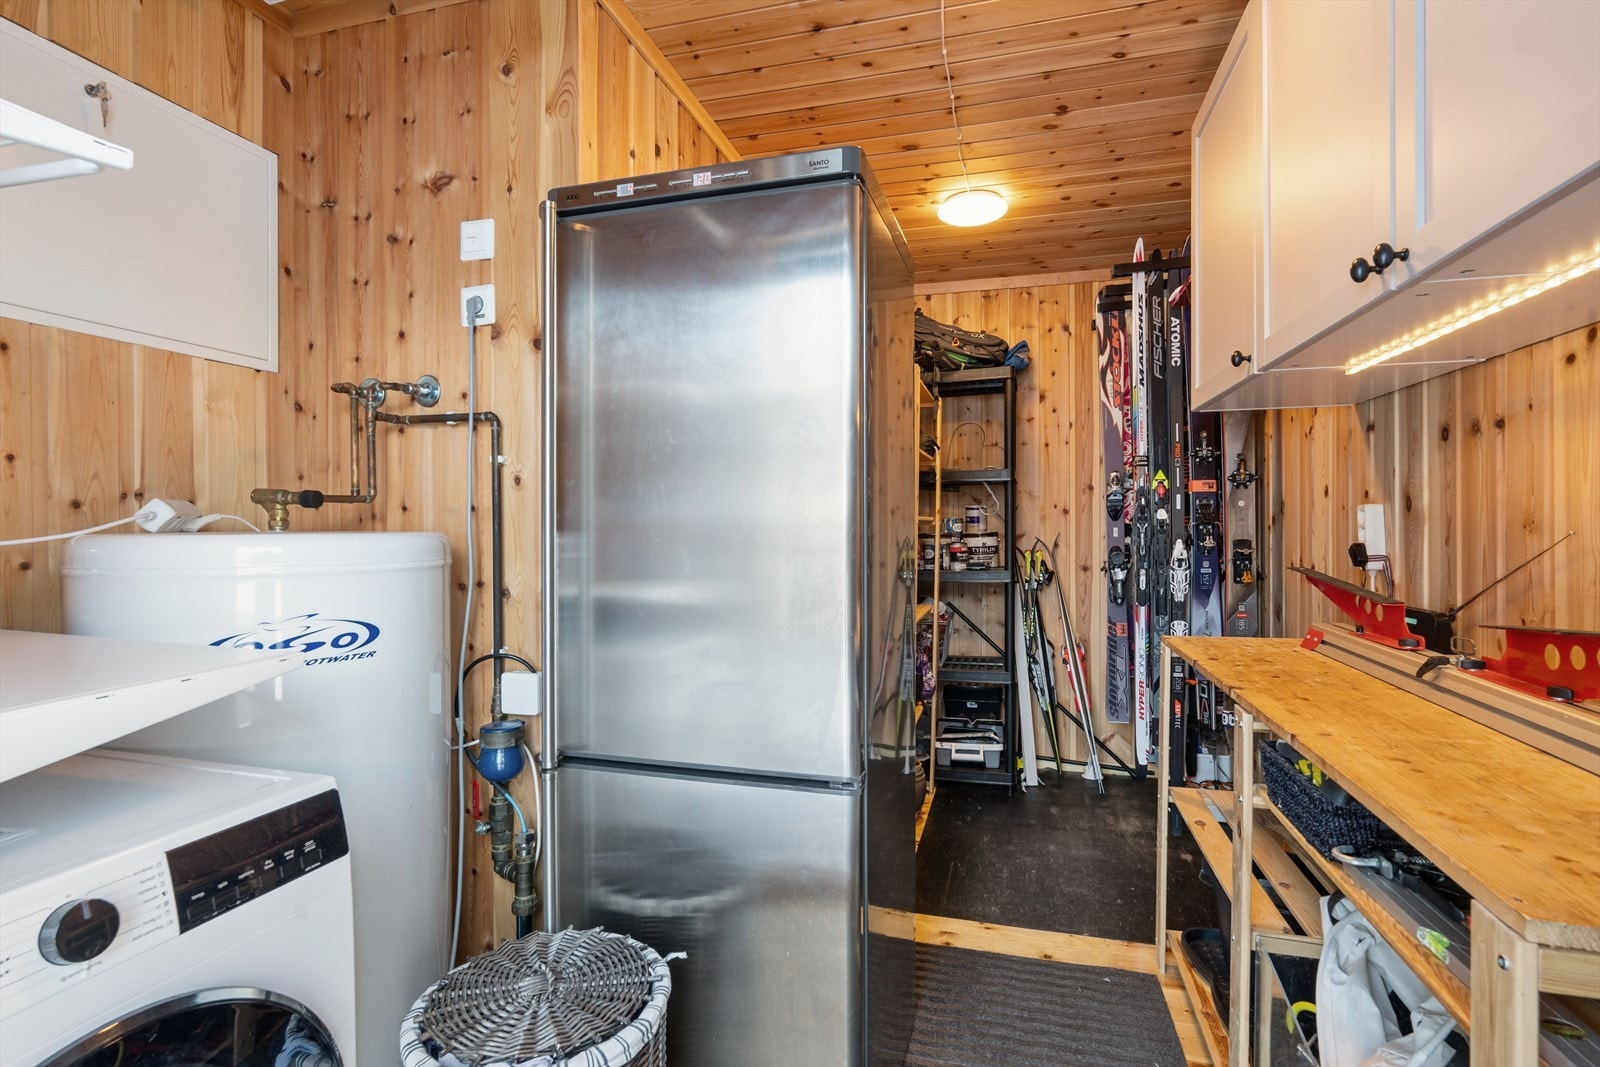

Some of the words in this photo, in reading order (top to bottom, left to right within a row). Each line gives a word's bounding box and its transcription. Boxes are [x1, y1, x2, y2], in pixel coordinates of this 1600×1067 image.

[809, 159, 829, 167] SANTO
[1137, 293, 1145, 387] MADSHUS
[1152, 295, 1163, 379] FISCHER
[1170, 316, 1181, 367] ATOMIC
[304, 650, 377, 667] OTWATER
[1107, 616, 1119, 719] stormrider
